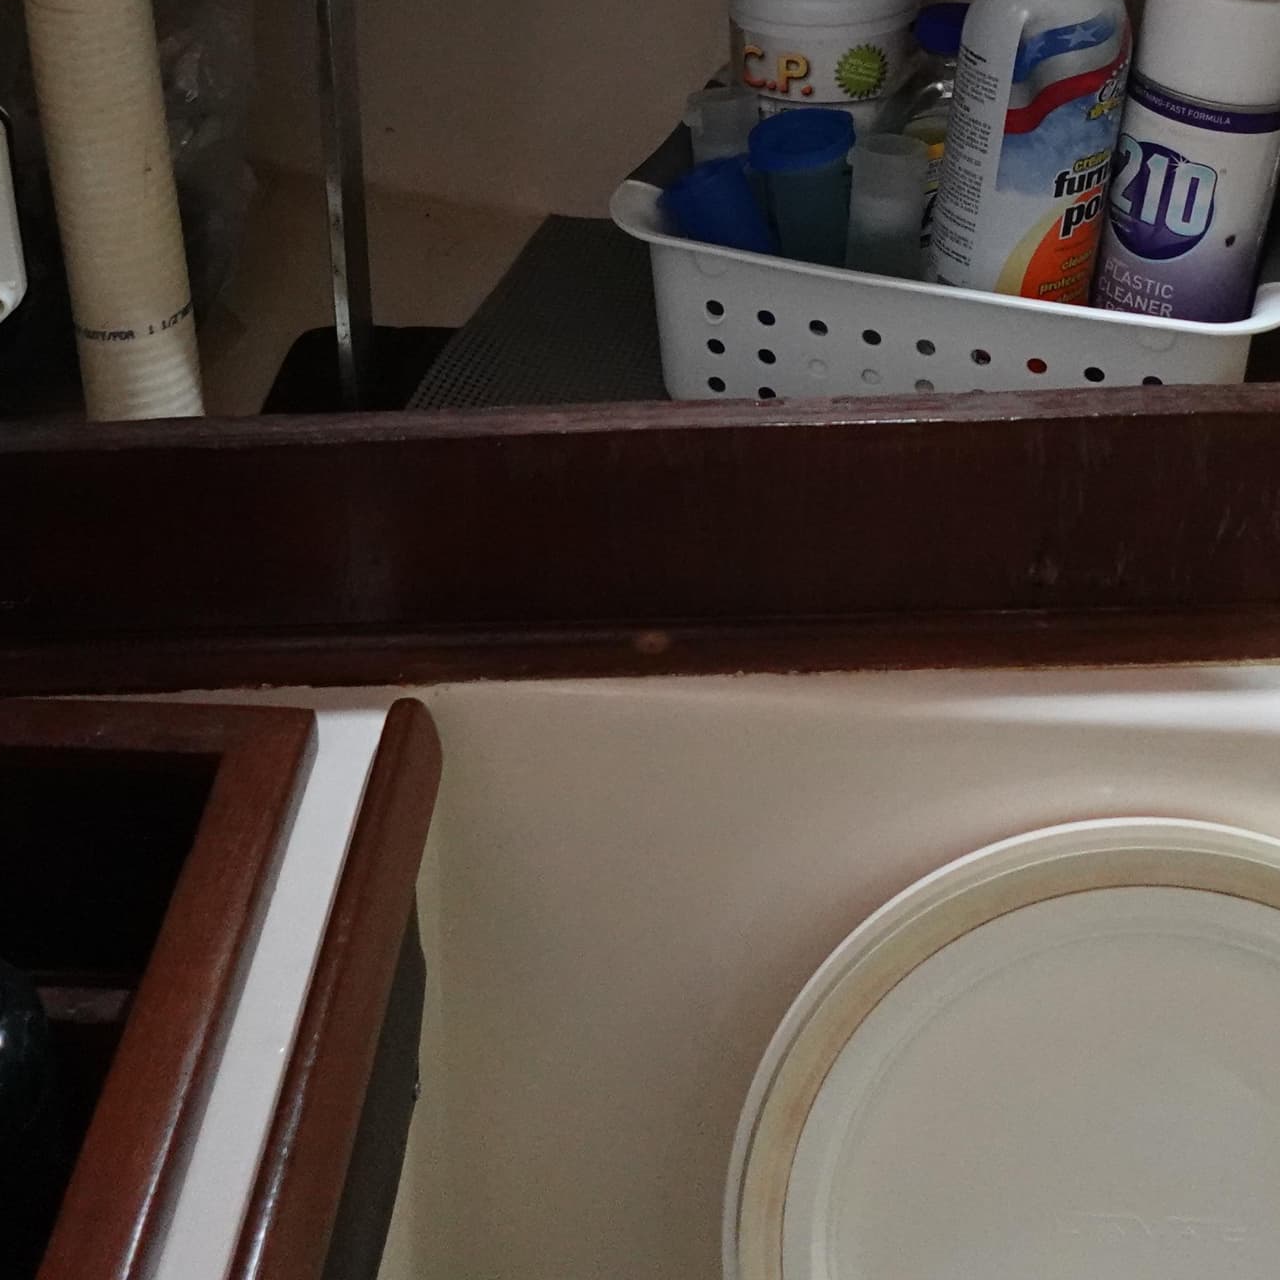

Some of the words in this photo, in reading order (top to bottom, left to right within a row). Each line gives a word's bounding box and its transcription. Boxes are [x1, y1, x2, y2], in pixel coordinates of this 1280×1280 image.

[1187, 110, 1231, 125] FORMULA
[1109, 133, 1218, 237] 210
[1098, 276, 1173, 317] CLEANER
[1104, 257, 1174, 299] PLASTIC
